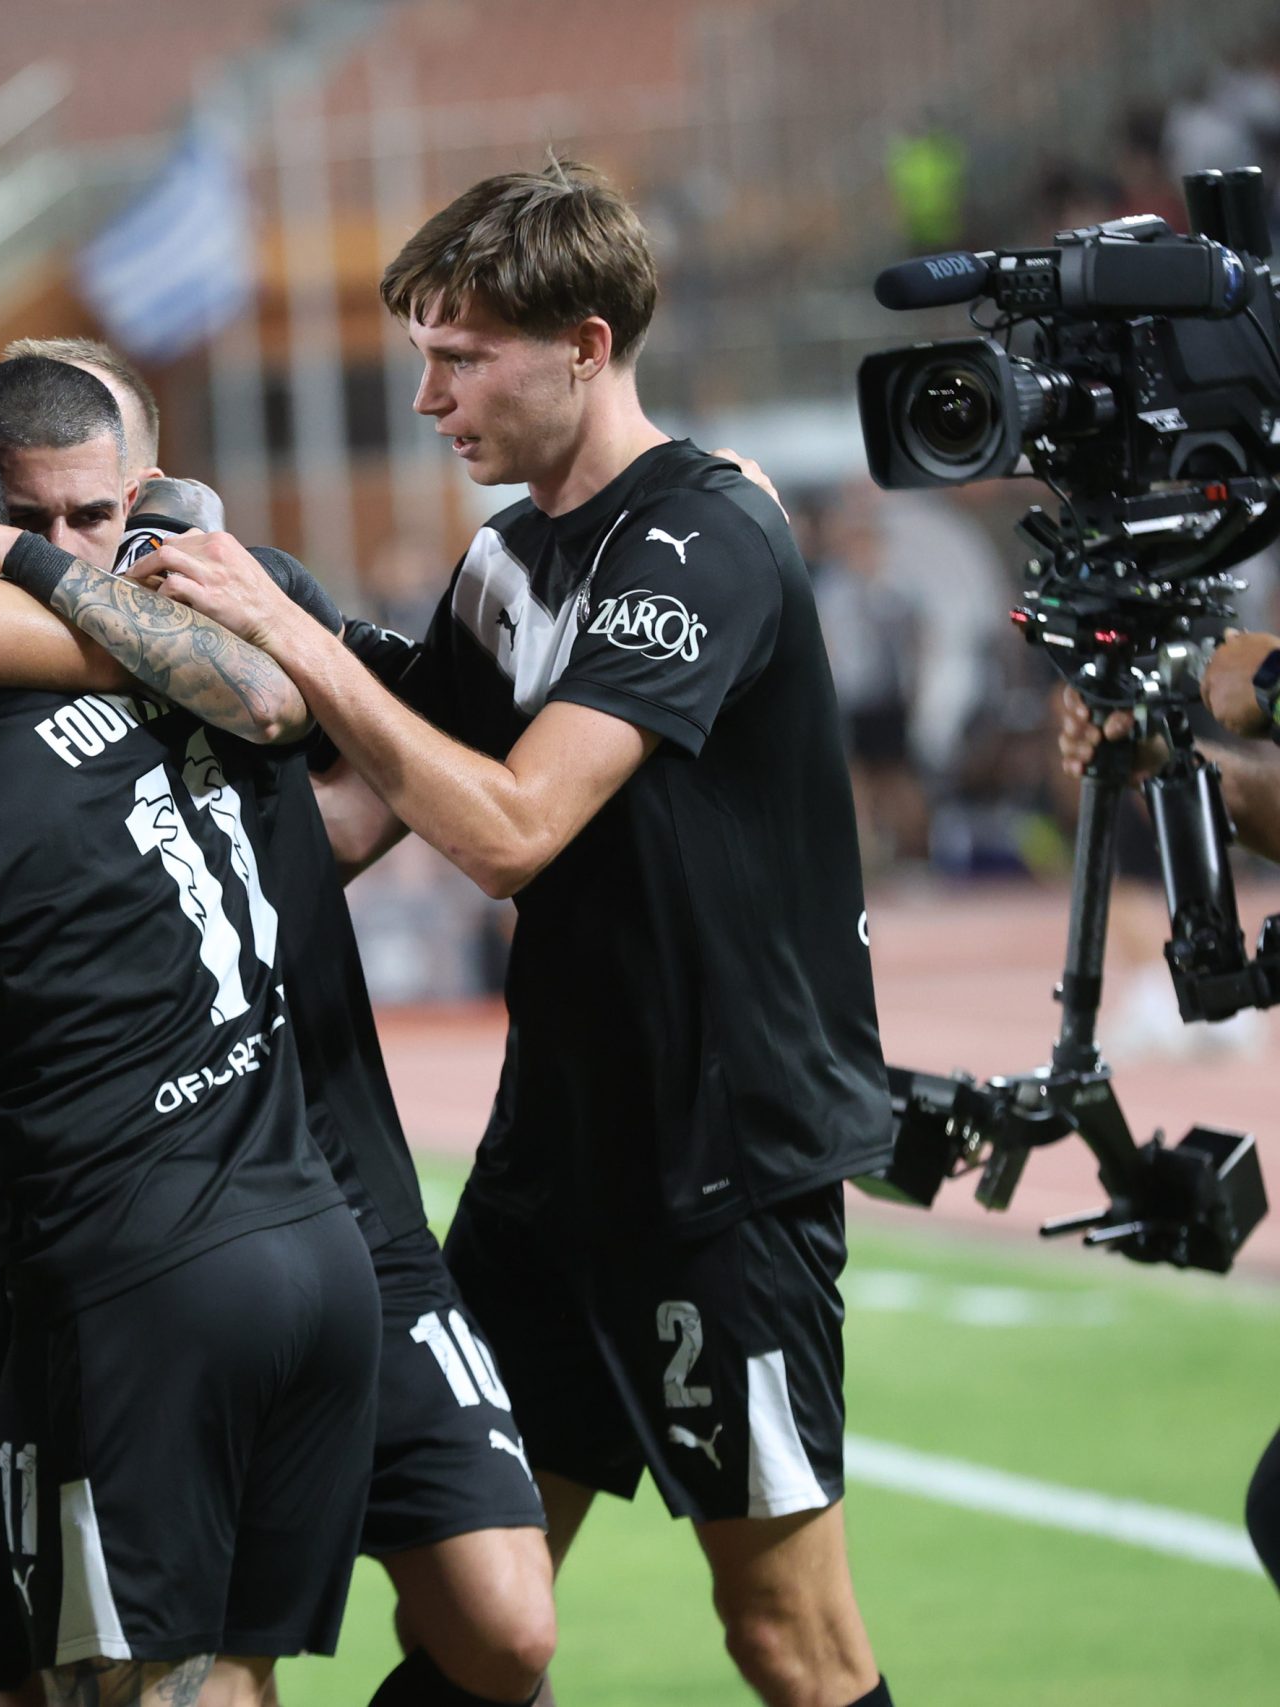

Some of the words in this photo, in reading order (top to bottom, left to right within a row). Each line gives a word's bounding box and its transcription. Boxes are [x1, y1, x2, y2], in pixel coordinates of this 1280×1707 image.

[587, 598, 708, 662] ZARO'S
[124, 725, 279, 1027] 11
[409, 1308, 512, 1413] 10
[656, 1300, 713, 1408] 2
